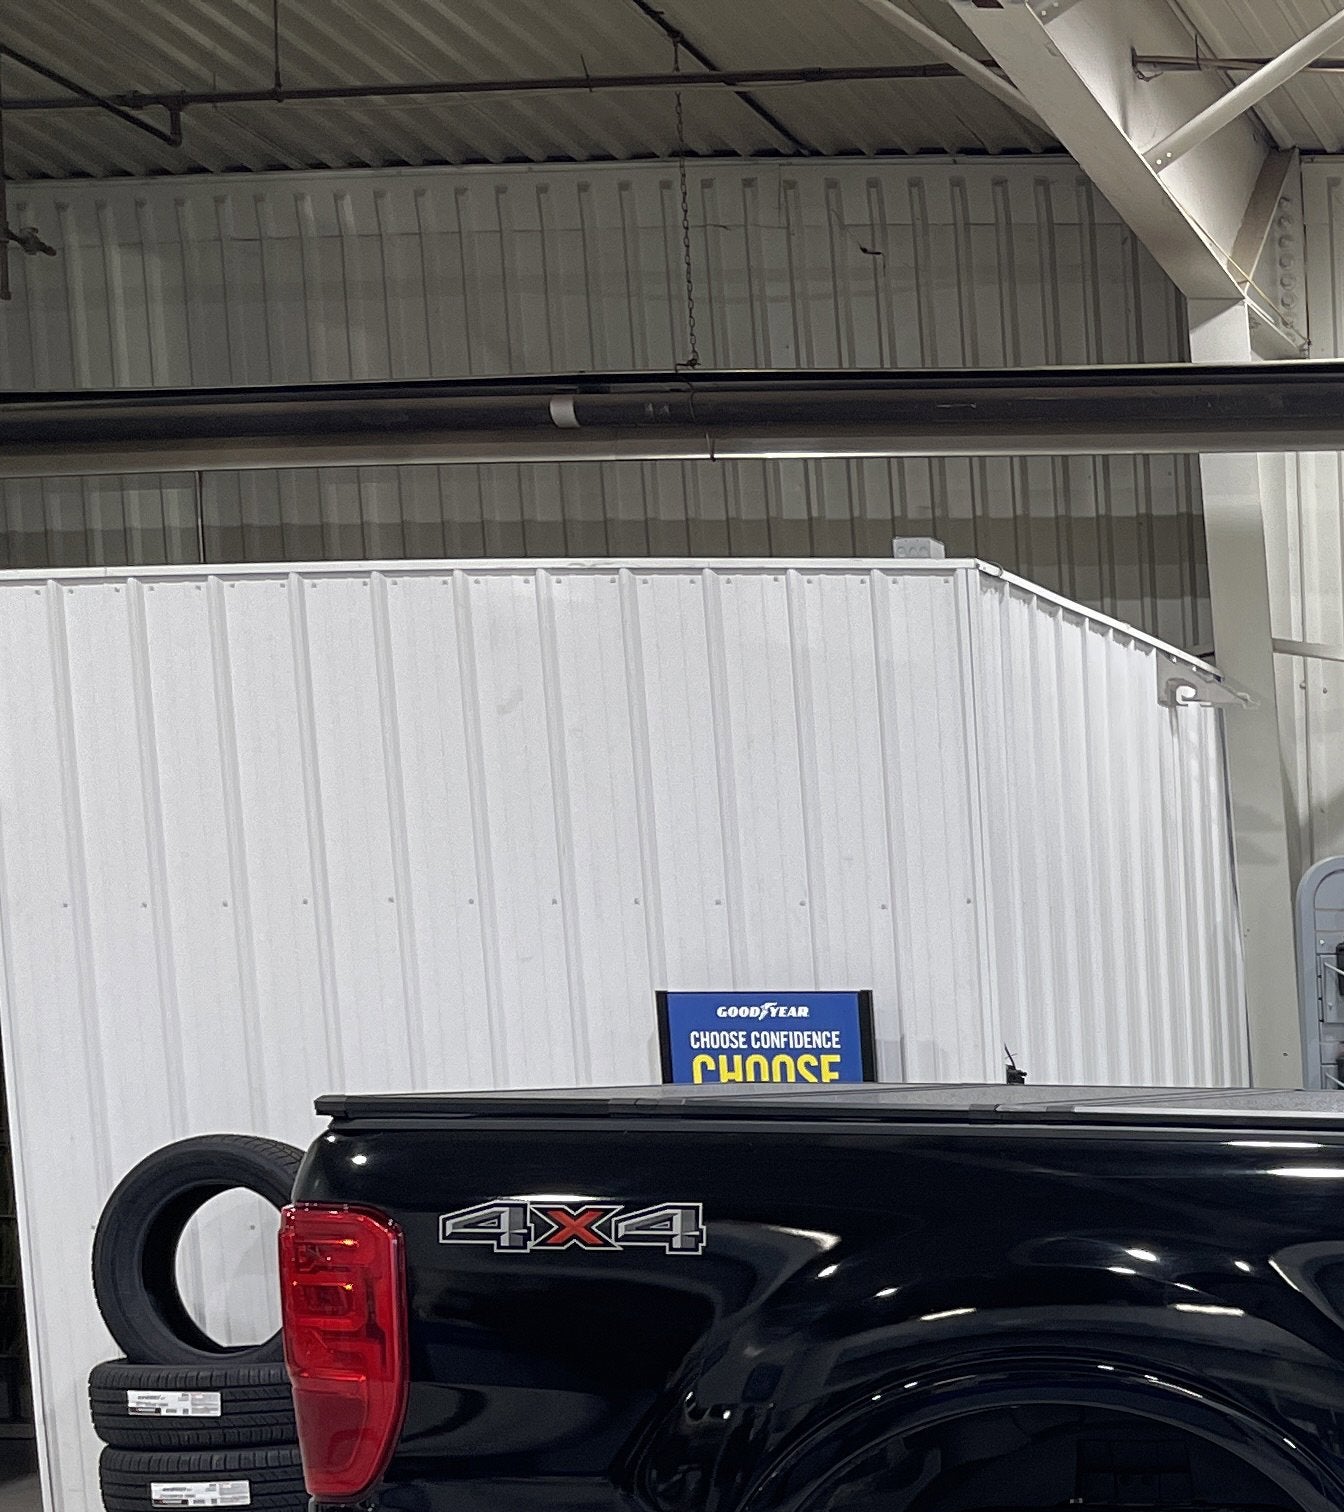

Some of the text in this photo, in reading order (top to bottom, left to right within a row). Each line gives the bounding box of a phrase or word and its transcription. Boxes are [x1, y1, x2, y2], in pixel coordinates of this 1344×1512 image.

[716, 1002, 810, 1020] GOODYEAR
[690, 1031, 841, 1048] CHOOSE CONFIDENCE
